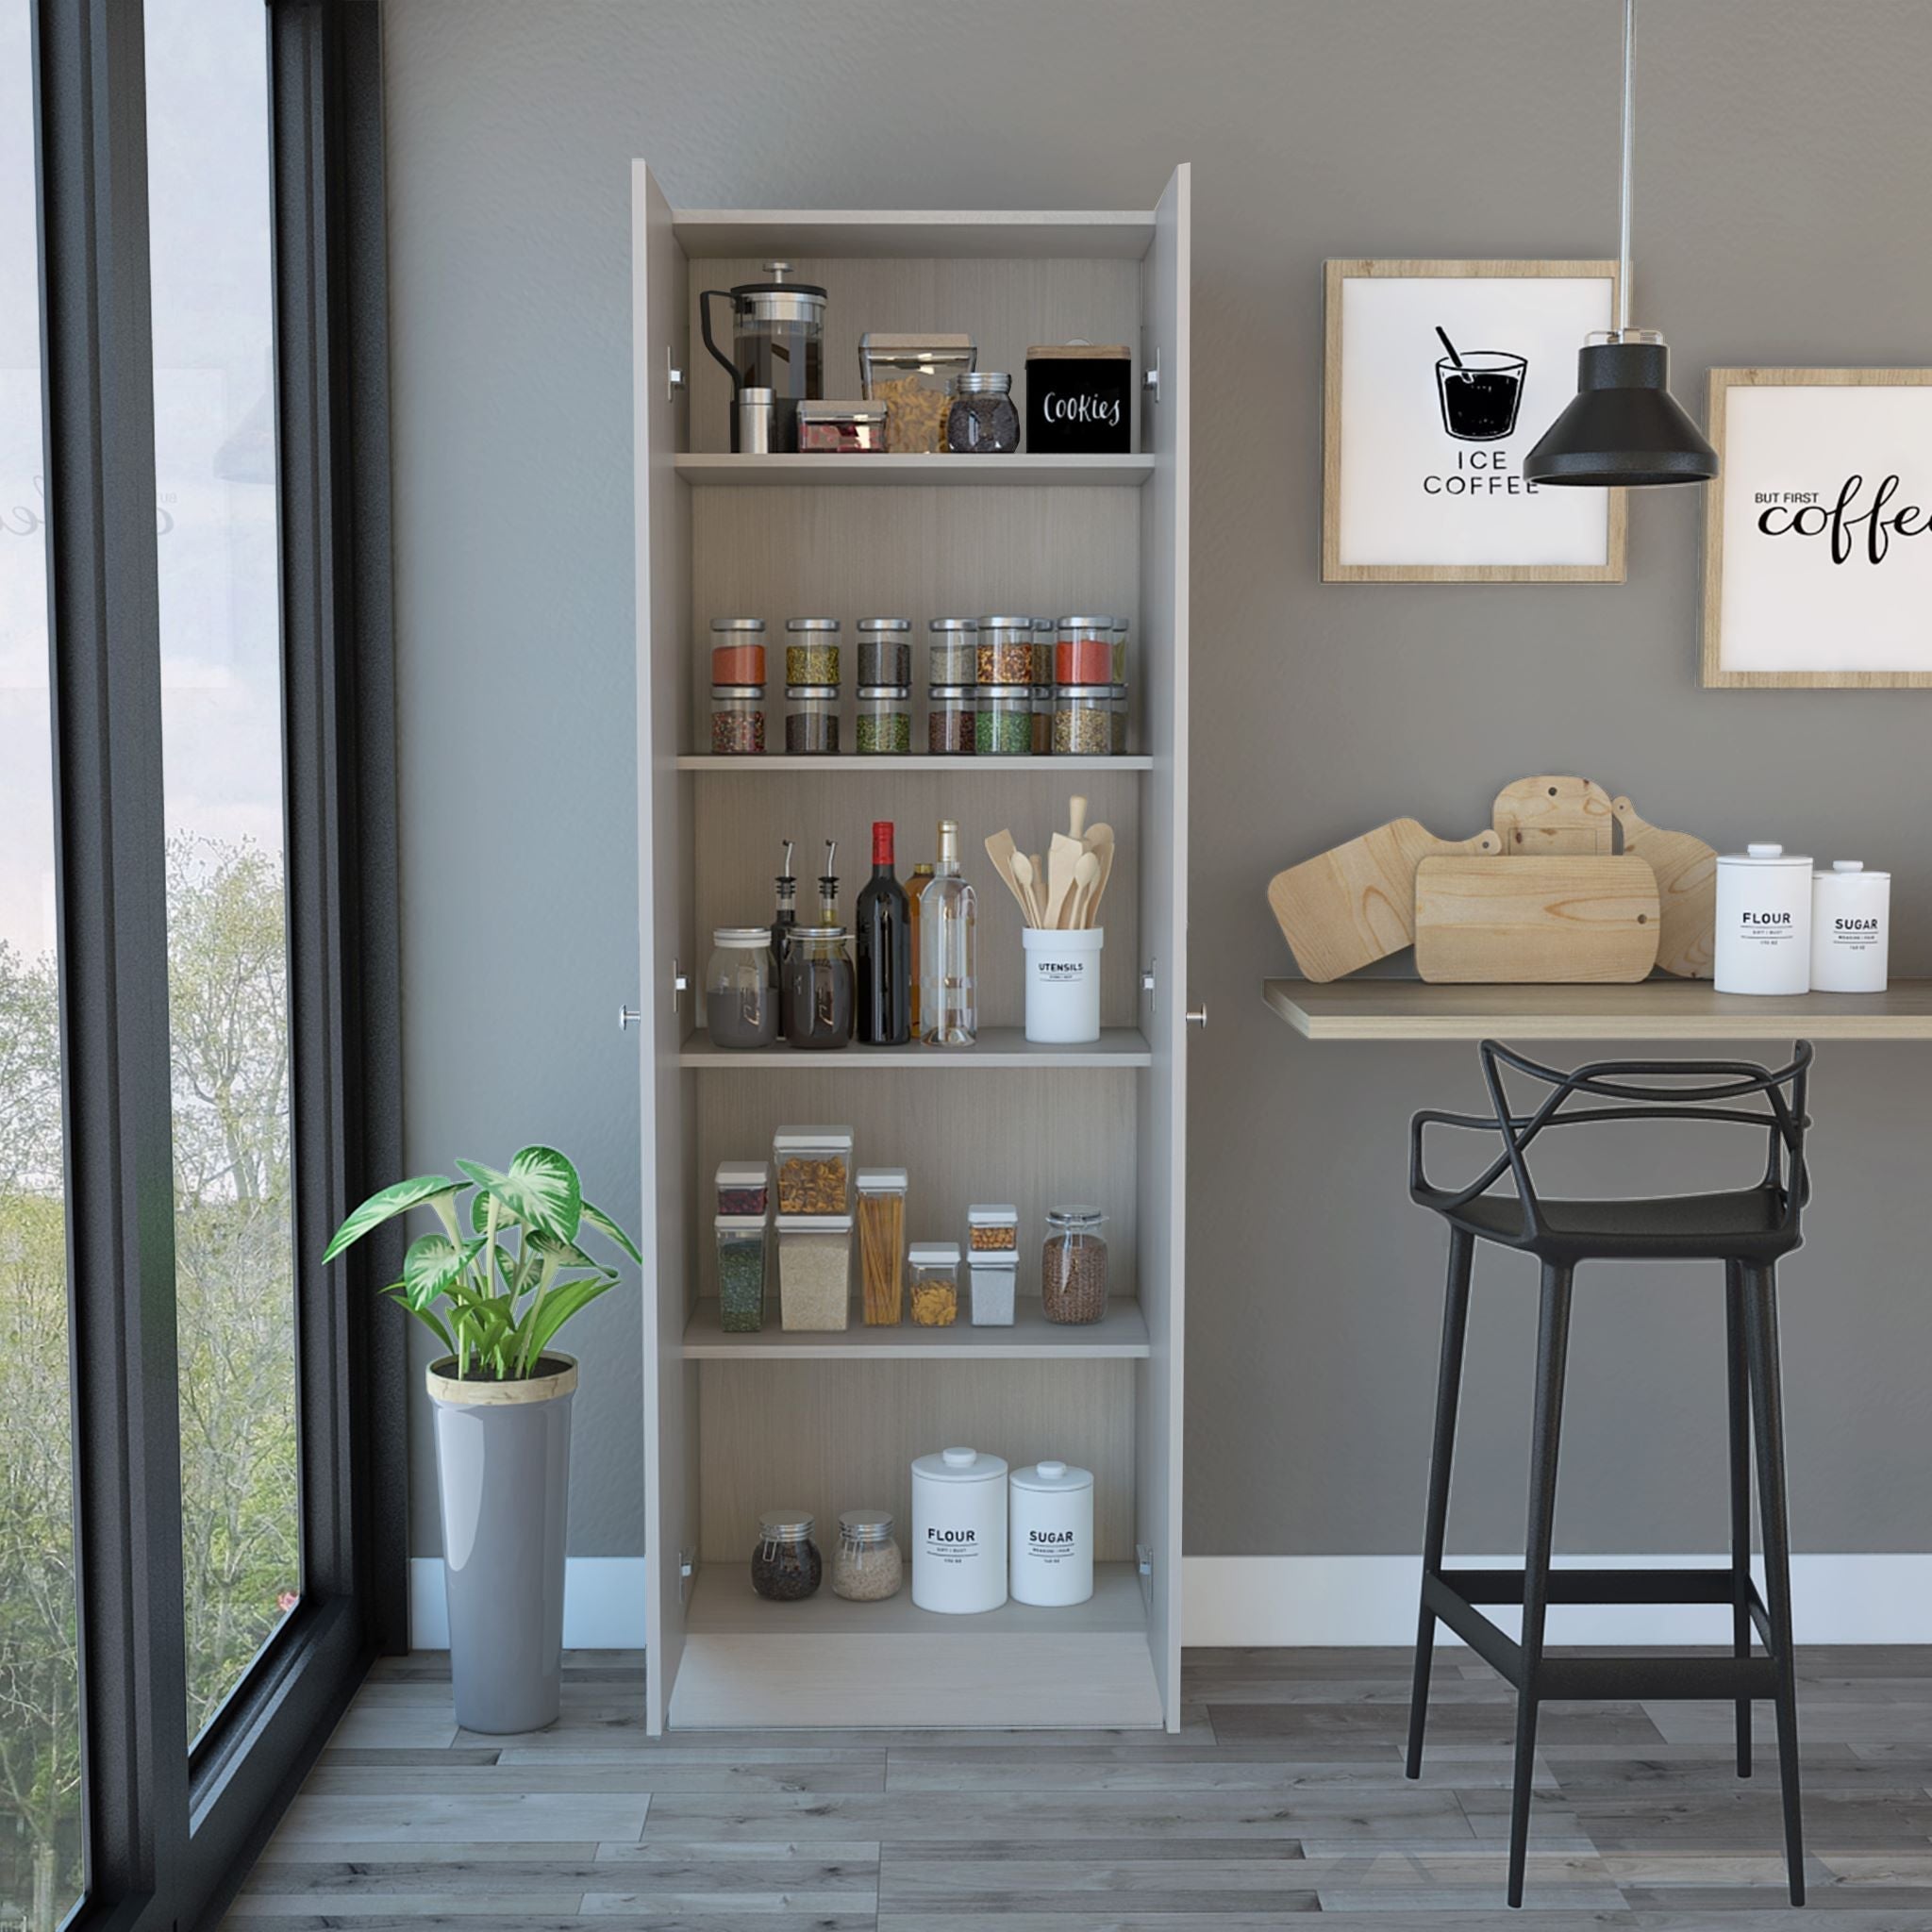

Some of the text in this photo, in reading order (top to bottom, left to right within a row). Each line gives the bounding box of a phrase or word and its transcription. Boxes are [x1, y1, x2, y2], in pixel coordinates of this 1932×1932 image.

[1043, 391, 1120, 426] Cookies
[1458, 451, 1507, 470] ICE
[1424, 475, 1540, 495] COFFEE
[1754, 491, 1820, 504] BUT FIRST
[1757, 474, 1932, 566] coffe
[1742, 911, 1791, 924] FLOUR
[1834, 918, 1879, 930] SUGAR
[1038, 962, 1084, 973] UTENSILS
[927, 1527, 975, 1542] FLOUR
[1029, 1529, 1074, 1543] SUGAR
